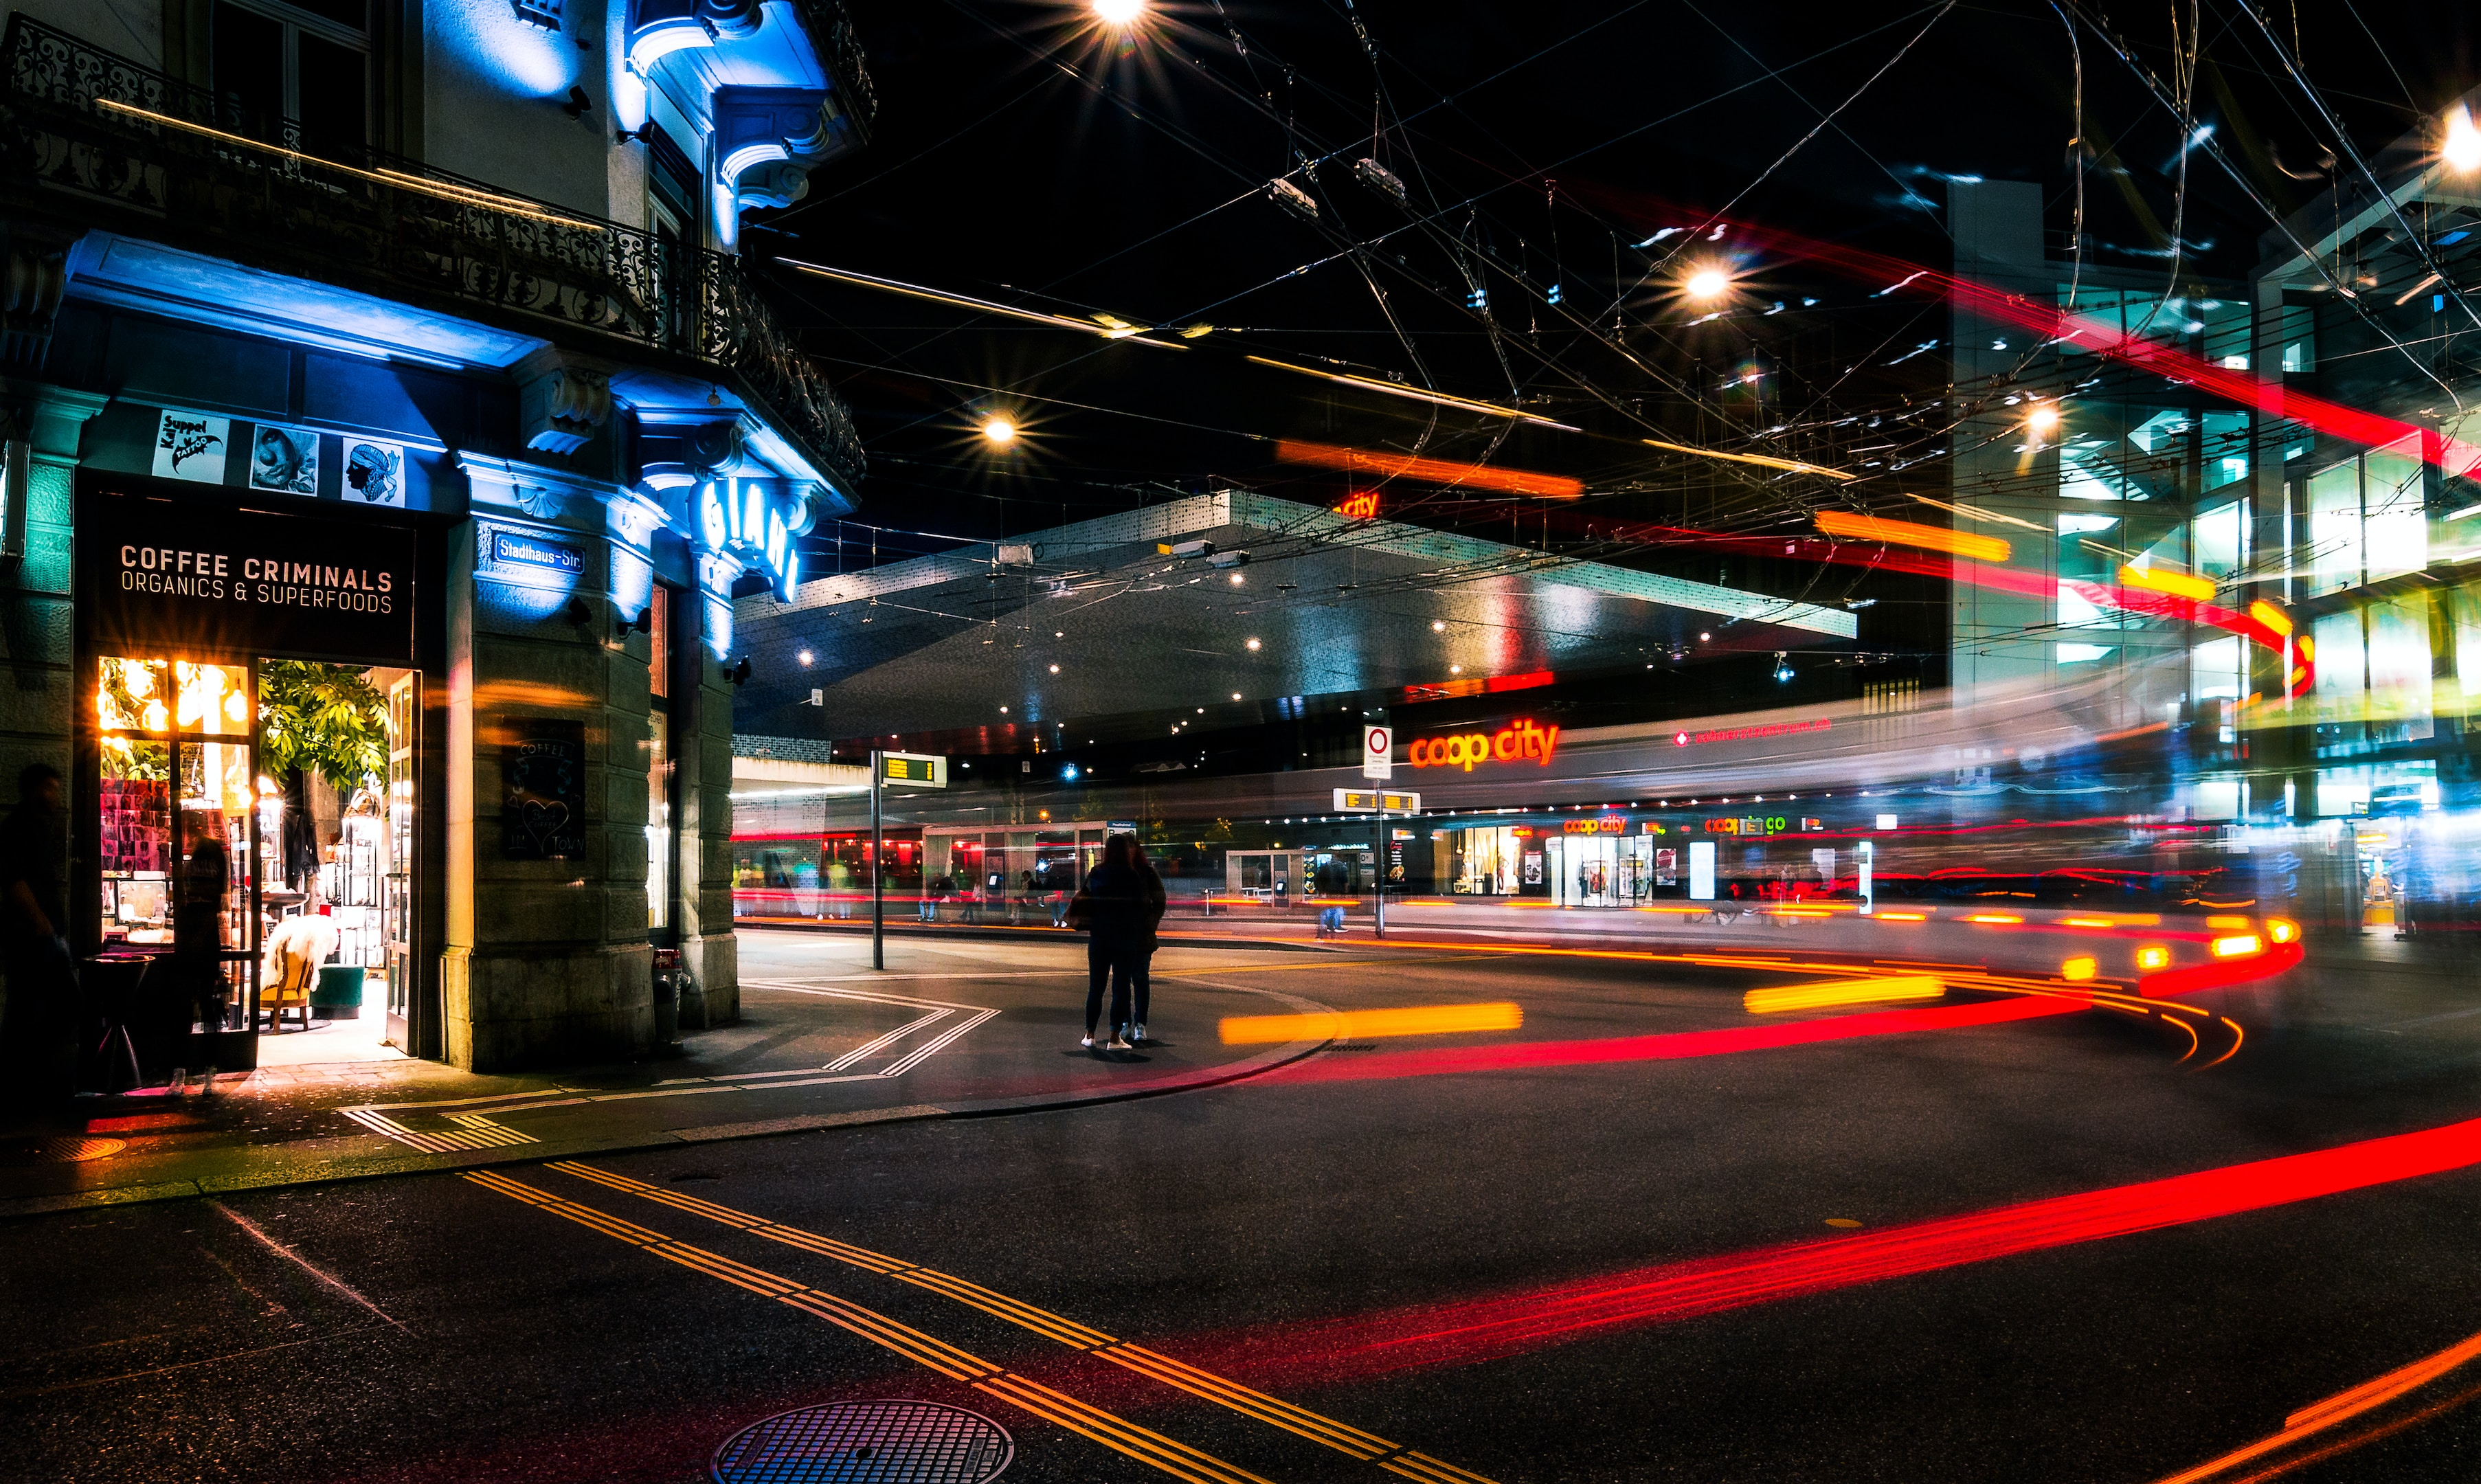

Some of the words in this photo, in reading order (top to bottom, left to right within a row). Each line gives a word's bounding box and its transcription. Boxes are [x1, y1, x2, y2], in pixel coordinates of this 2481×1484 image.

[176, 437, 207, 458] TATTOO
[1343, 492, 1378, 517] city
[499, 539, 581, 568] Stadthaus-Str.
[121, 545, 228, 577] COFFEE
[244, 558, 392, 592] CRIMINALS
[122, 570, 224, 598] ORGANICS
[234, 582, 247, 601] &
[257, 583, 392, 614] SUPERFOODS
[520, 742, 566, 757] COFFEE
[1409, 733, 1490, 773] coop
[1493, 718, 1559, 766] city
[531, 809, 556, 821] Best
[1563, 819, 1599, 835] coop
[1599, 813, 1628, 835] city
[552, 835, 585, 852] TOWN
